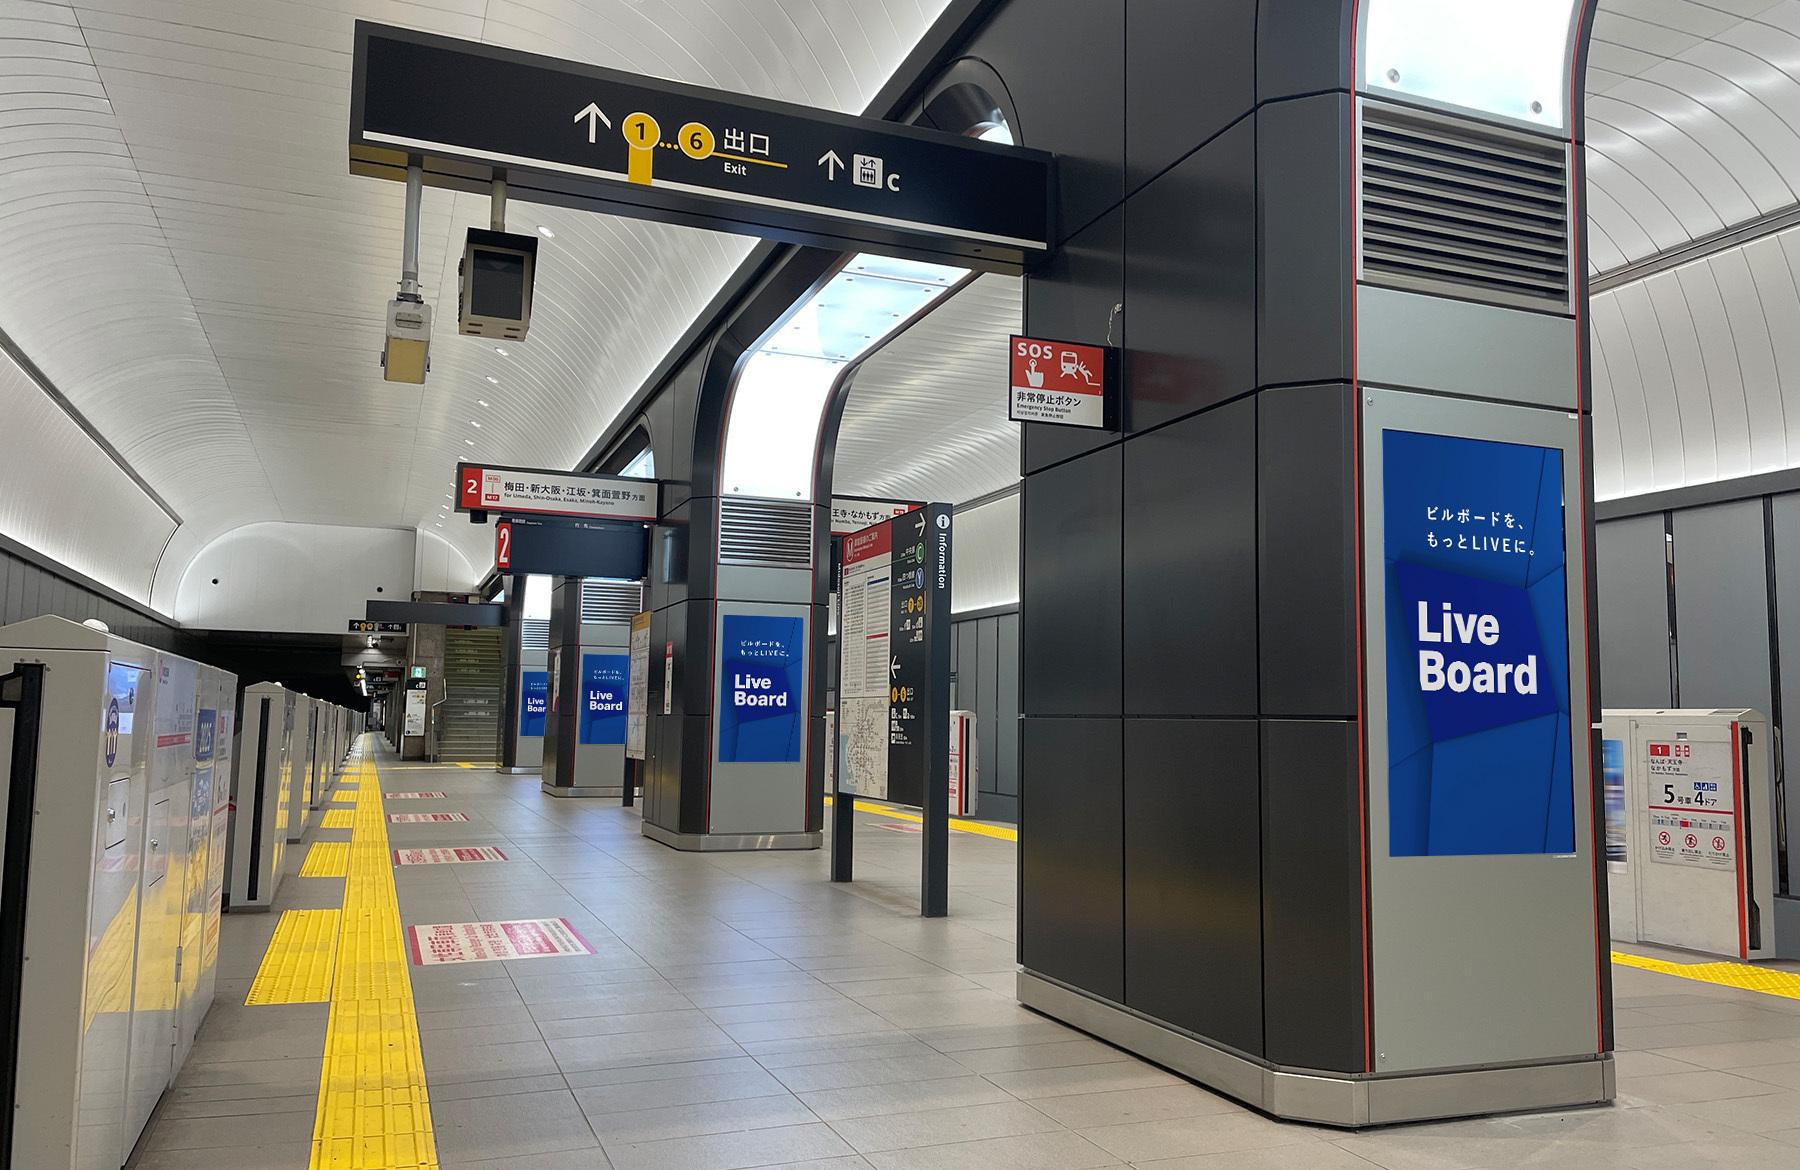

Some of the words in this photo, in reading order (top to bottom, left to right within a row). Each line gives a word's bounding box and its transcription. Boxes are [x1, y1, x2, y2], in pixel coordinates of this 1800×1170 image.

[635, 122, 646, 140] 1
[690, 132, 702, 150] 6
[724, 128, 770, 156] 出口
[724, 162, 747, 176] Exit
[1017, 342, 1053, 360] SOS
[1016, 392, 1082, 407] 非常停止ボタン
[467, 479, 478, 494] 2
[1426, 506, 1524, 530] ビルボードを、
[500, 528, 508, 563] 2
[1426, 532, 1536, 556] もっとLIVEに。
[938, 533, 948, 589] Information
[1417, 600, 1500, 646] Live
[1418, 650, 1538, 695] Board
[734, 674, 772, 690] Live
[589, 690, 613, 700] Live
[734, 690, 787, 707] Board
[589, 701, 623, 711] Board
[1657, 746, 1662, 754] 1
